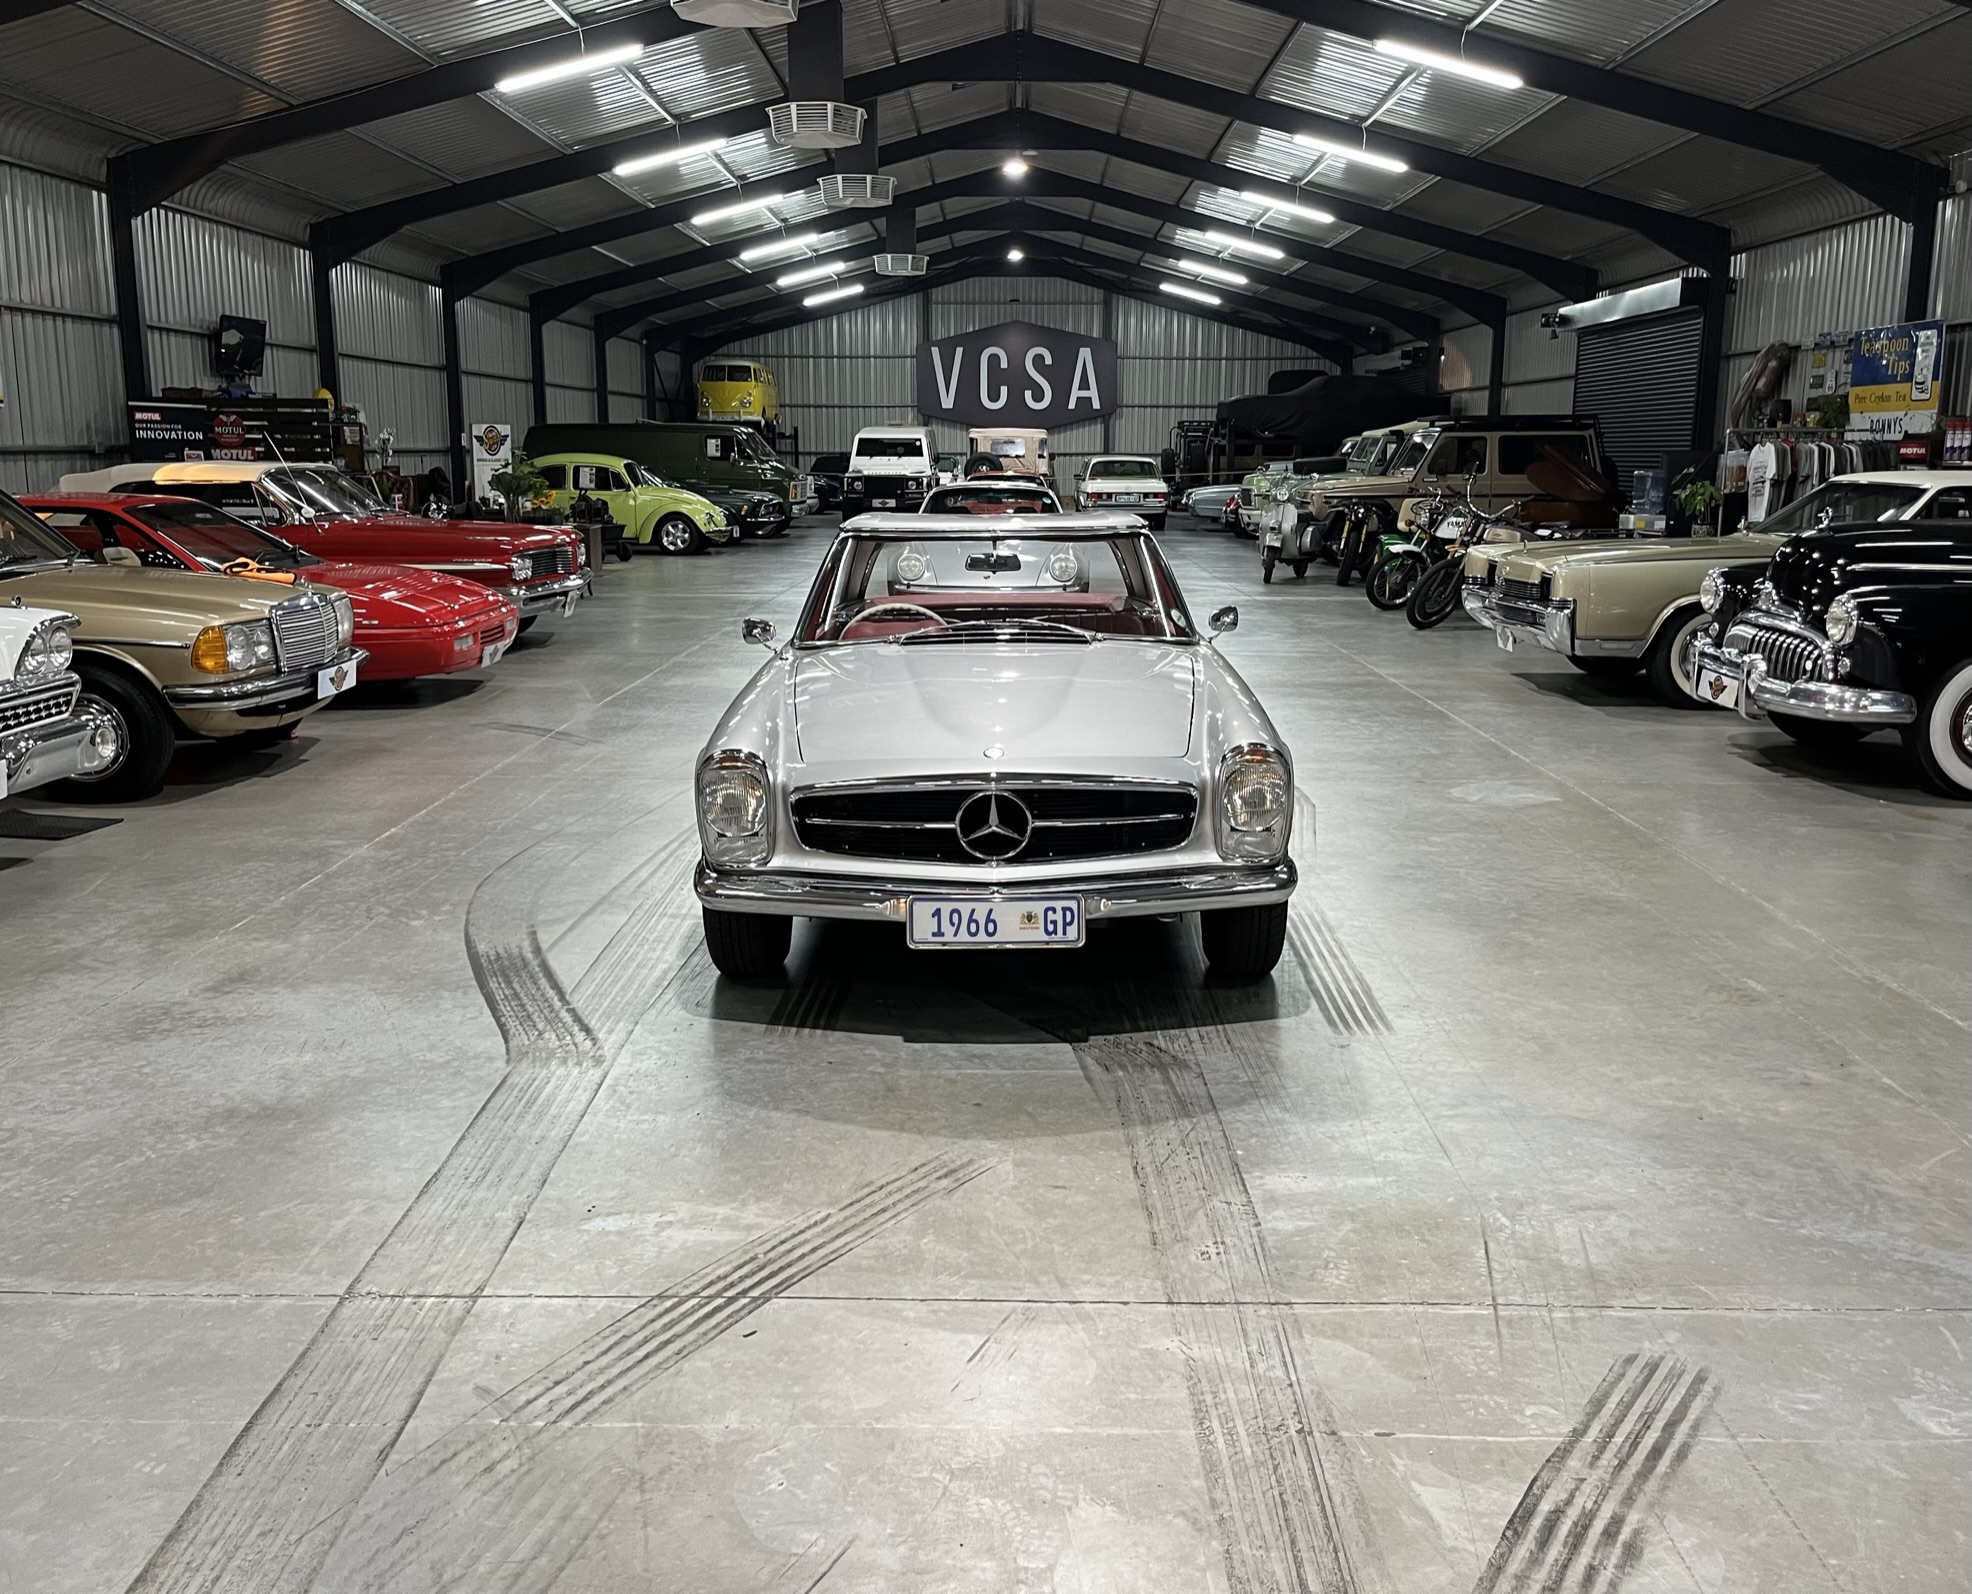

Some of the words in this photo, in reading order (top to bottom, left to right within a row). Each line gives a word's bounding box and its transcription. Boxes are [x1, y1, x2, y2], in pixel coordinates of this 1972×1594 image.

[1860, 336, 1909, 358] Teaspoon
[1888, 355, 1910, 380] Tips
[930, 346, 1101, 411] VCSA
[1855, 394, 1867, 404] Pure
[1869, 392, 1892, 405] Ceylon
[1895, 391, 1907, 402] Tea
[135, 412, 161, 420] MOTUL
[214, 426, 245, 434] MOTUL
[1870, 418, 1903, 434] RONNYS
[136, 430, 203, 440] INNOVATION
[211, 448, 254, 460] MOTUL
[931, 907, 998, 938] 1966
[1043, 906, 1076, 937] GP
